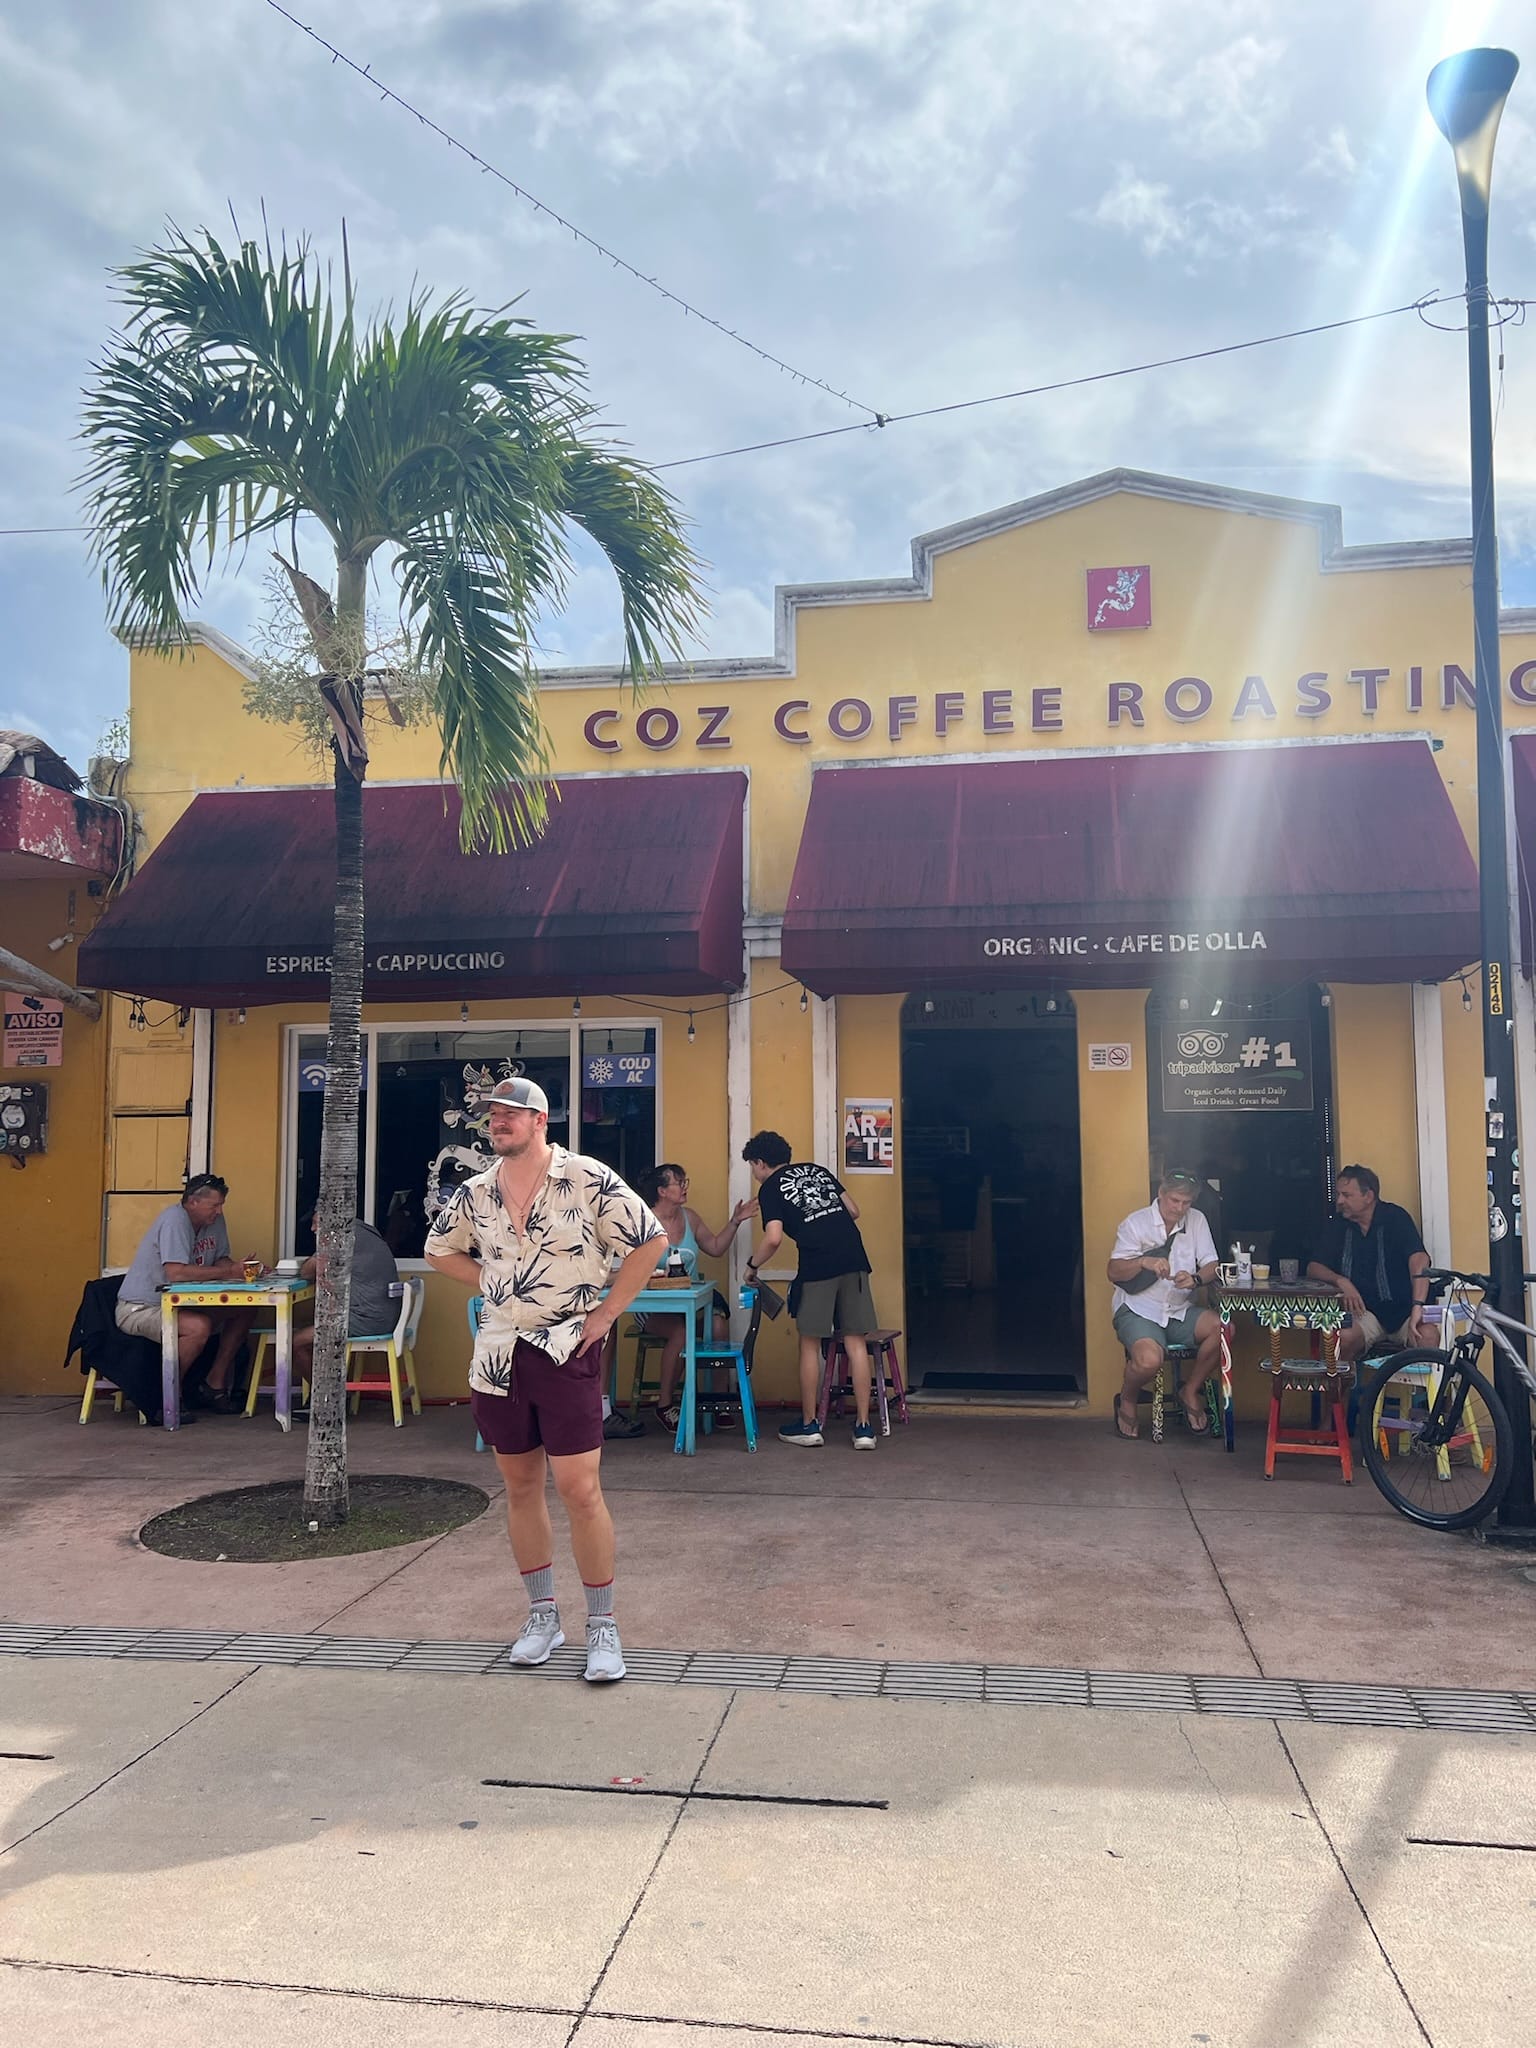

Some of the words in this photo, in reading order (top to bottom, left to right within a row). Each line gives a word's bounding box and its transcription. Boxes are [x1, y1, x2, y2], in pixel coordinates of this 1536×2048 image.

[583, 706, 733, 753] COZ
[774, 687, 1065, 743] COFFEE
[1105, 934, 1163, 954] CAFE
[1169, 933, 1200, 953] DE
[1205, 931, 1267, 951] OLLA
[376, 951, 505, 972] CAPPUCCINO
[1490, 964, 1501, 1013] 02146
[8, 1013, 60, 1028] AVISO
[1240, 1037, 1297, 1067] #1
[619, 1057, 651, 1070] COLD
[626, 1071, 644, 1083] AC
[1184, 1087, 1213, 1096] Organic
[1214, 1087, 1237, 1095] Coffee
[1239, 1086, 1265, 1095] Roasted
[1268, 1086, 1287, 1096] Daily
[1239, 1097, 1260, 1105] Great
[1261, 1097, 1279, 1105] Food
[845, 1115, 877, 1136] AR
[862, 1137, 892, 1160] TE
